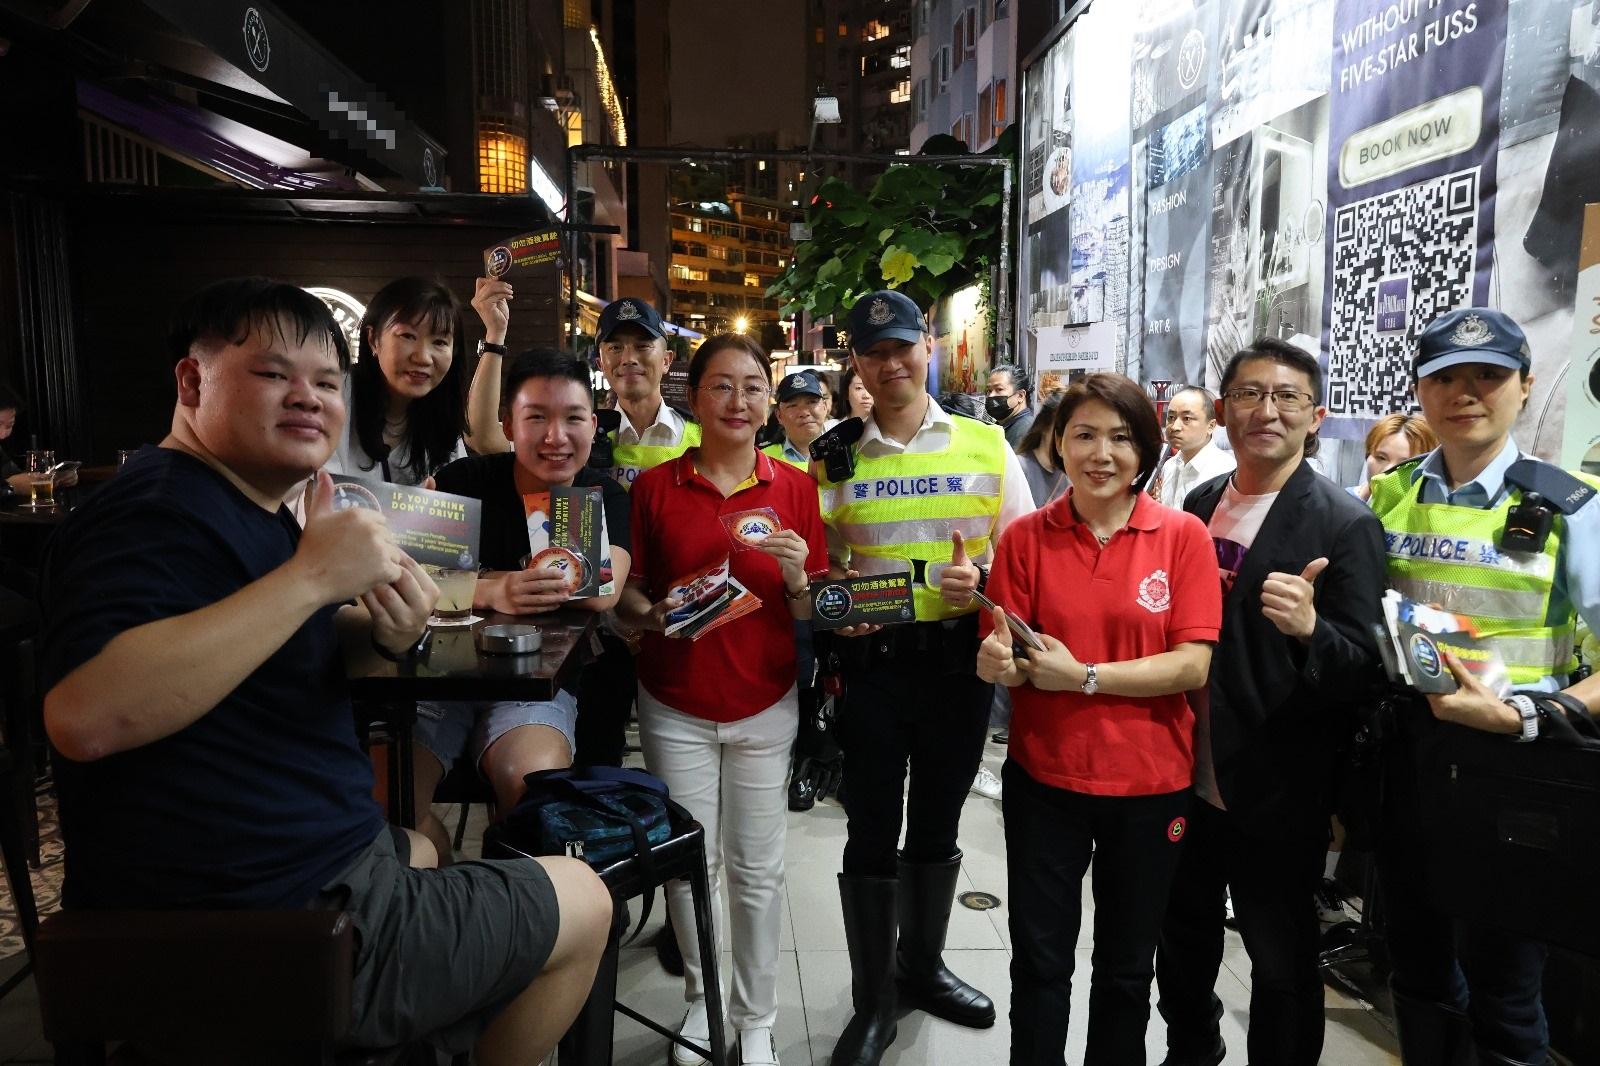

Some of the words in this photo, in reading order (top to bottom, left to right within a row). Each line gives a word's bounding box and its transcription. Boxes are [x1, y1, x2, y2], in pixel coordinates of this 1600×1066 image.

[1340, 33, 1419, 94] FIVE-STAR
[1424, 3, 1478, 53] FUSS
[1359, 133, 1402, 165] BOOK
[1407, 115, 1452, 147] NOW
[1152, 189, 1187, 216] FASHION
[1150, 251, 1181, 273] DESIGN
[1148, 319, 1164, 334] ART
[1164, 318, 1171, 332] &
[853, 483, 869, 499] 警
[876, 477, 938, 496] POLICE
[946, 476, 962, 492] 察
[391, 500, 425, 513] DON'T
[392, 491, 403, 501] IF
[407, 493, 428, 505] YOU
[433, 498, 465, 513] DRINK
[1398, 535, 1469, 561] POLICE
